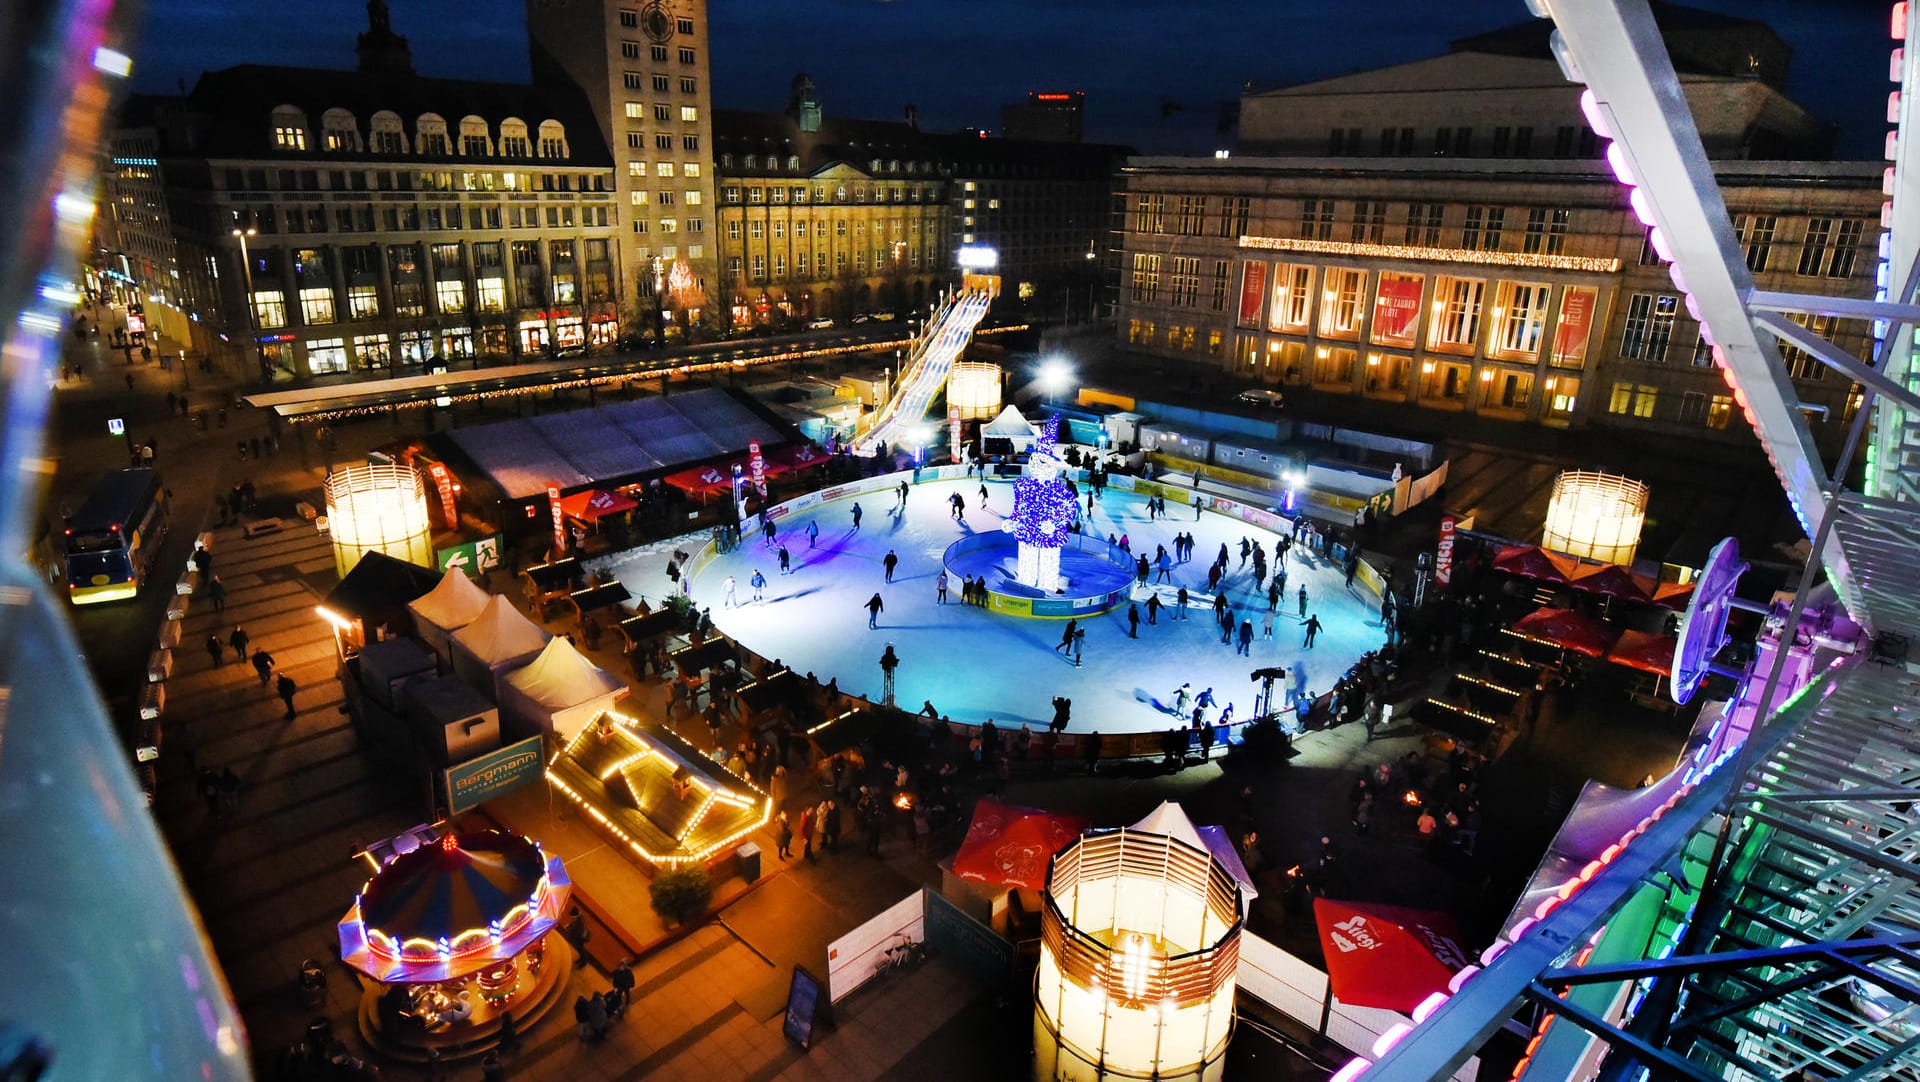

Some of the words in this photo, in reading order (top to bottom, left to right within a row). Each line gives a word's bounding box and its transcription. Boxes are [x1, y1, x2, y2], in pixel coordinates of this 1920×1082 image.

[1393, 298, 1416, 310] ZAUBER
[1565, 296, 1585, 326] HEUTE
[456, 751, 537, 790] Bergmann
